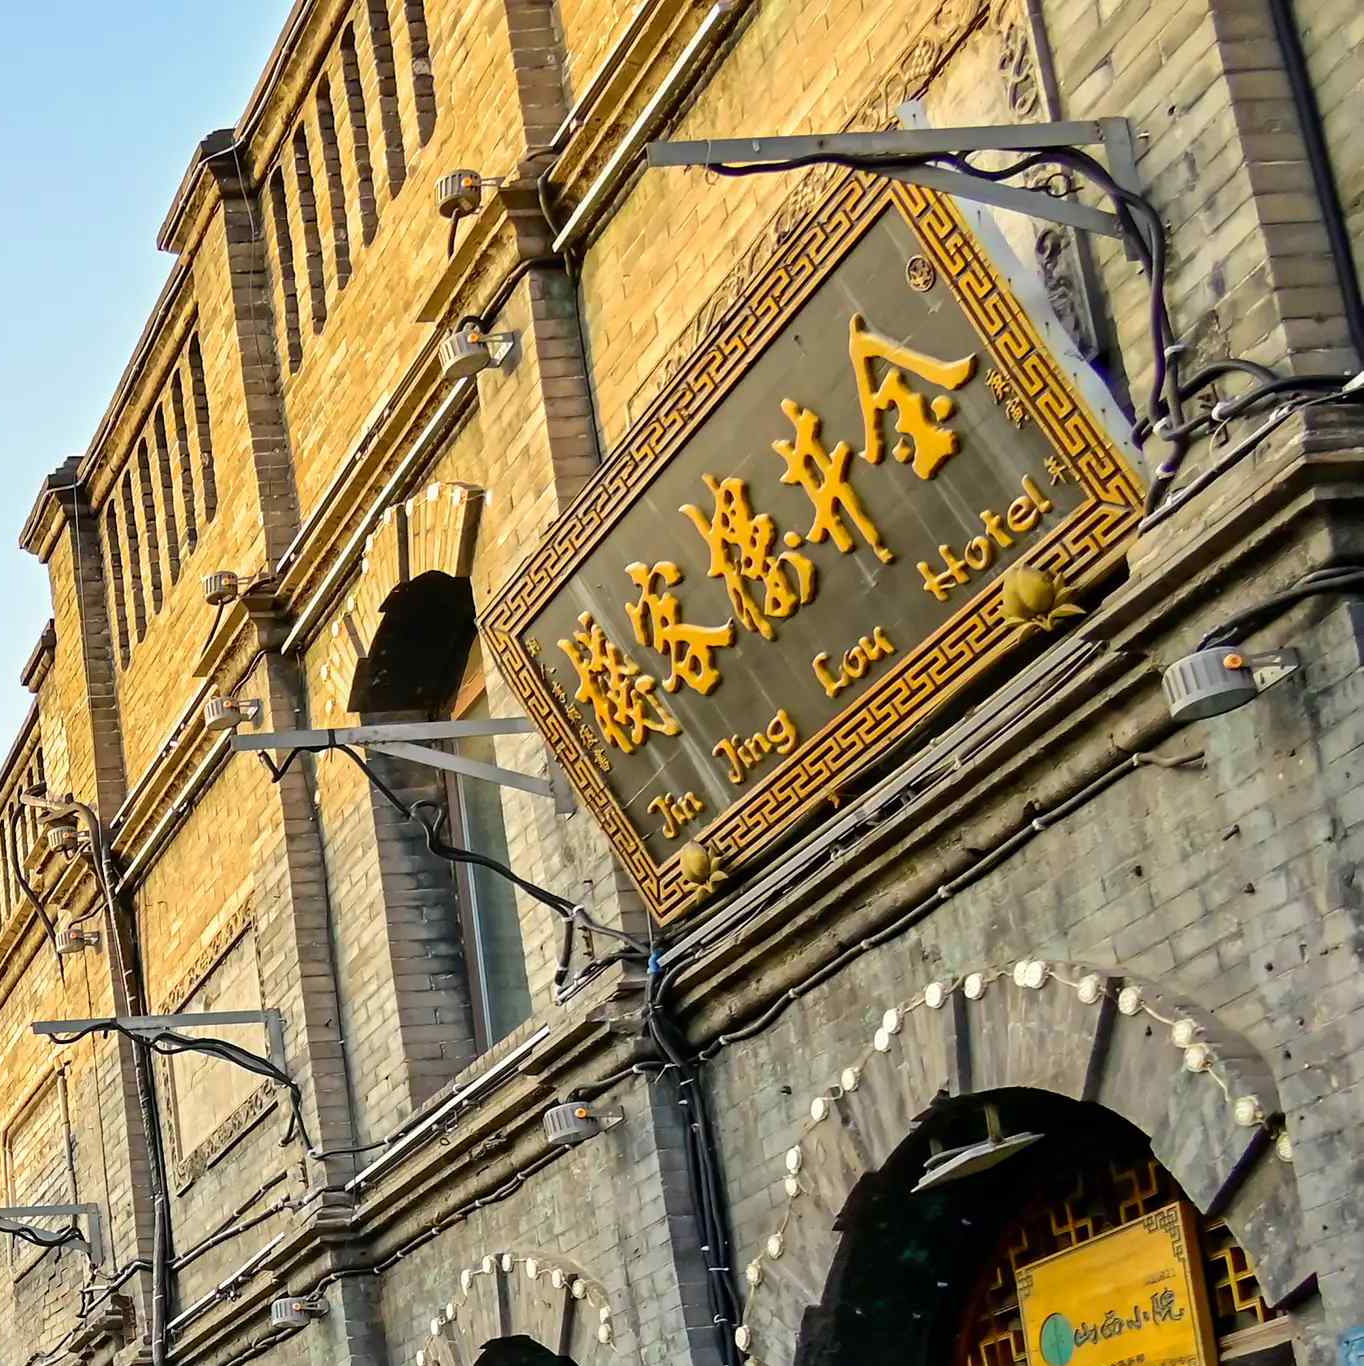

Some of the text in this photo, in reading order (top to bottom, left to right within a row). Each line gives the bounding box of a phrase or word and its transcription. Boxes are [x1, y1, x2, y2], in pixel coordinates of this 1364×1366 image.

[646, 474, 1054, 839] Jin Jing Lou Hotel
